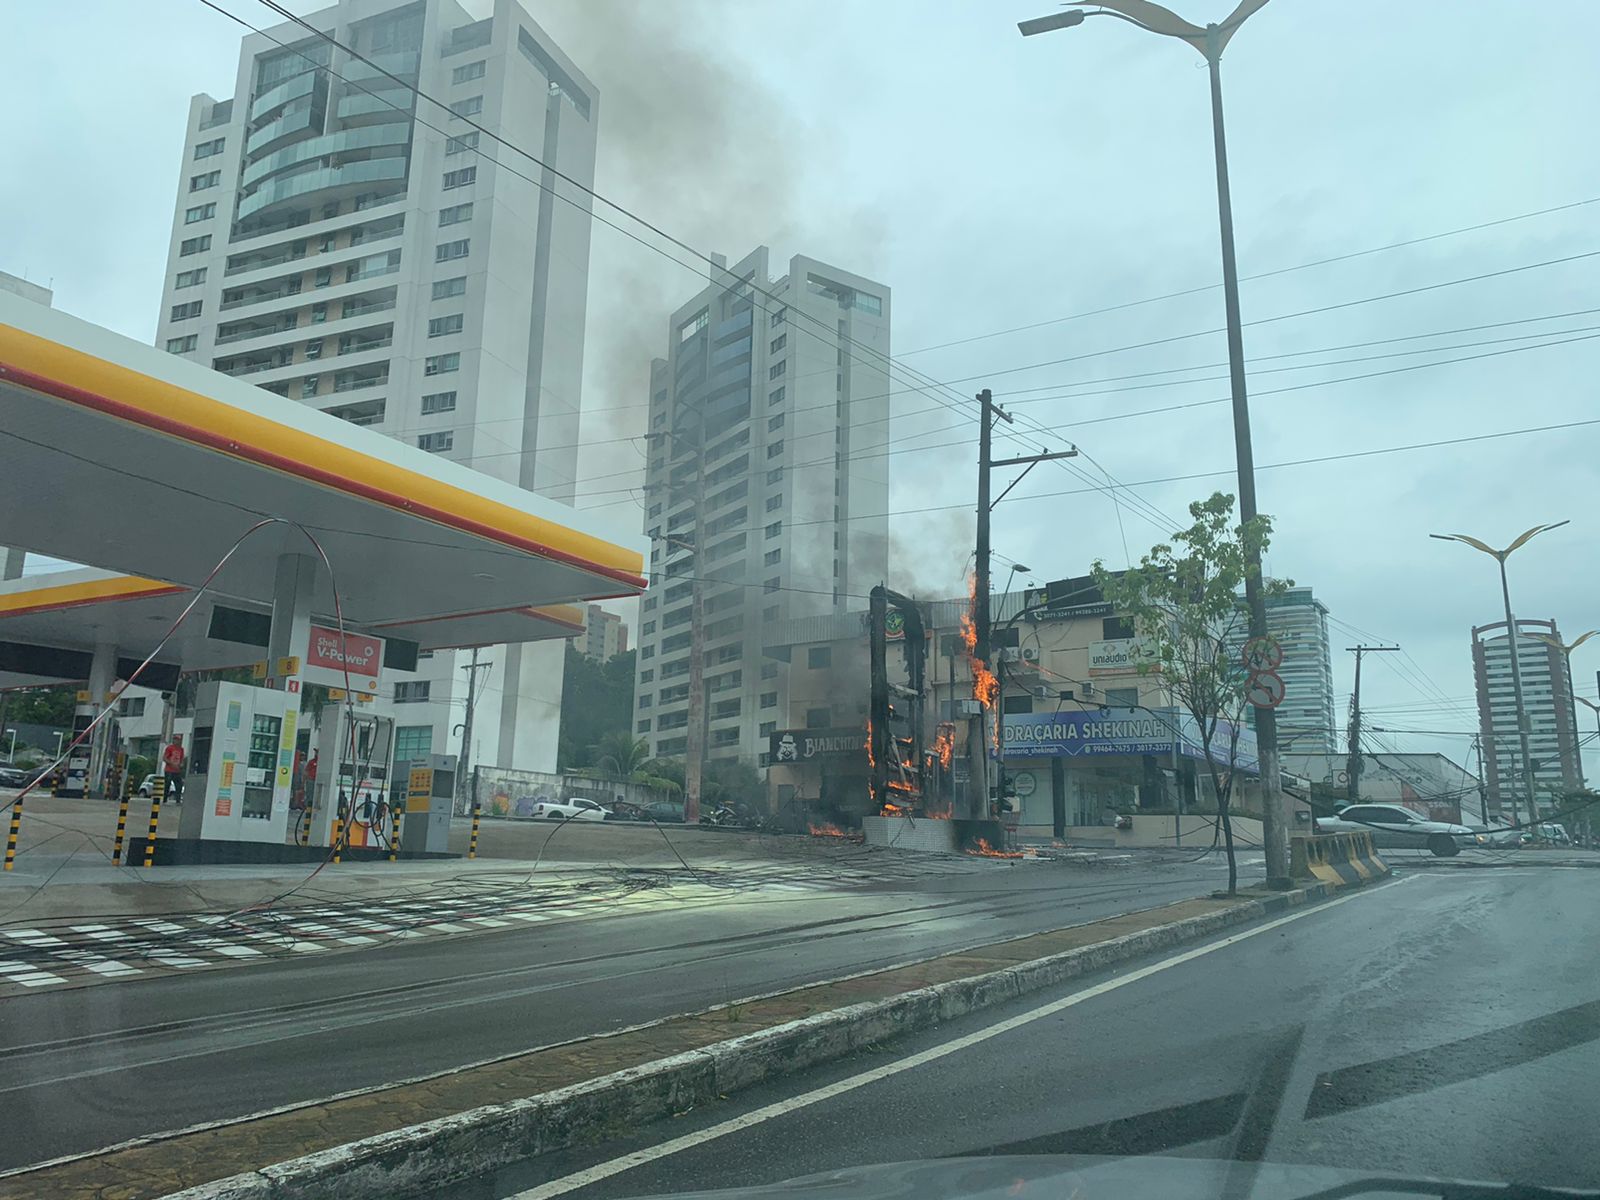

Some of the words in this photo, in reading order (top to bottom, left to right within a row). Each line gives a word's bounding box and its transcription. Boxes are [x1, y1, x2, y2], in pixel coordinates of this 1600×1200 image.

[318, 637, 338, 648] Shell
[317, 646, 368, 667] V-Power
[989, 723, 1078, 744] DRAÇARIA
[1082, 719, 1165, 739] SHEKINAH
